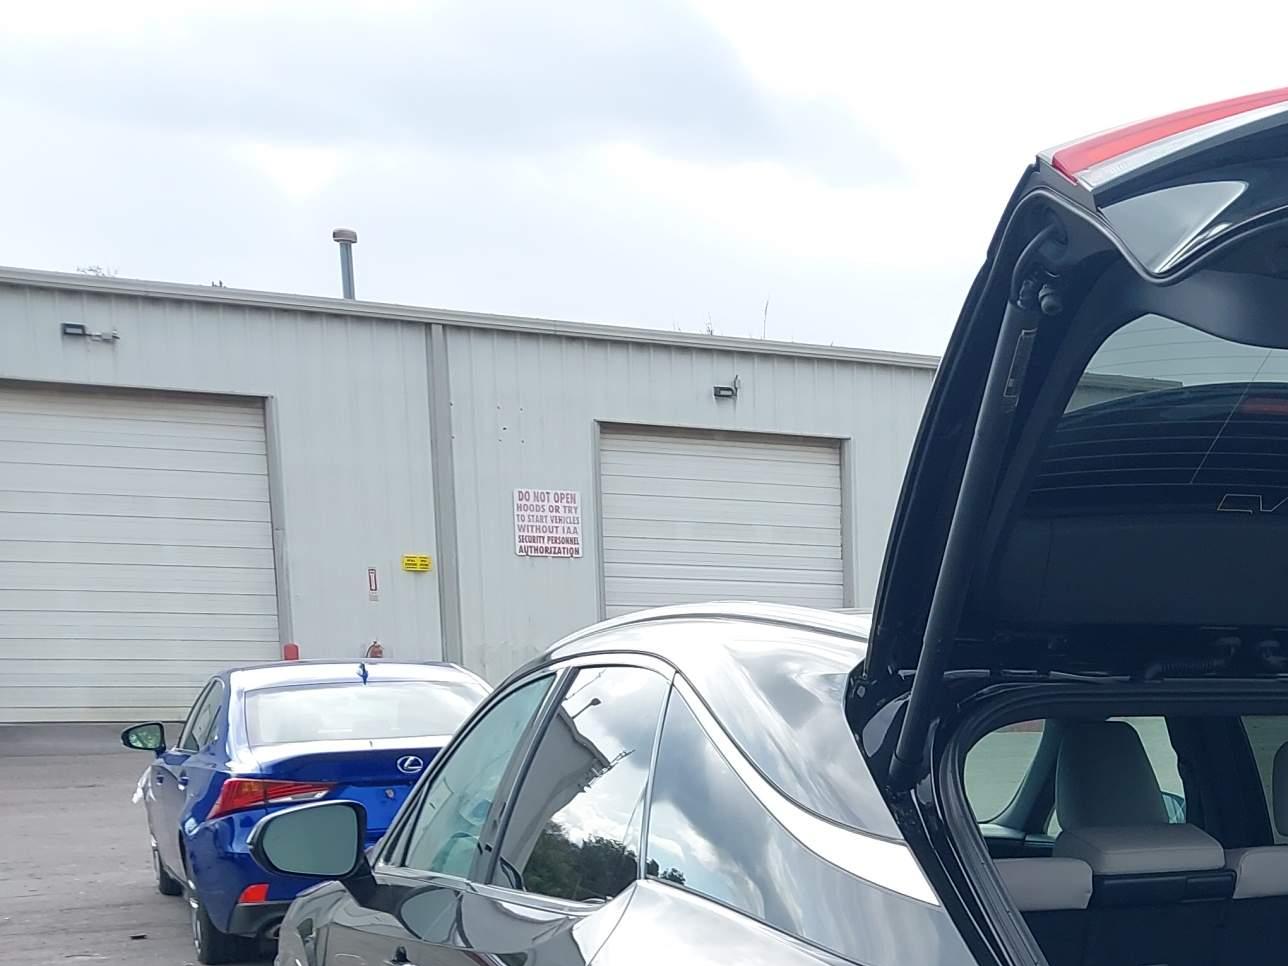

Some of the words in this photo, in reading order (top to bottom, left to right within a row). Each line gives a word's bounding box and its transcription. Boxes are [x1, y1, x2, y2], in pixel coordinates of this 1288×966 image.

[518, 491, 530, 502] DO
[533, 491, 550, 503] NOT
[554, 492, 577, 504] OPEN
[516, 503, 546, 513] HOODS
[548, 504, 561, 513] OR
[563, 505, 578, 514] TRY
[516, 514, 525, 522] TO
[528, 514, 548, 523] START
[550, 515, 580, 525] VEHICLES
[517, 524, 559, 534] WITHOUT
[562, 525, 578, 535] IAA
[518, 535, 545, 544] SECURITY
[547, 536, 580, 545] PERSONNEL
[518, 545, 580, 556] AUTHORIZATION
